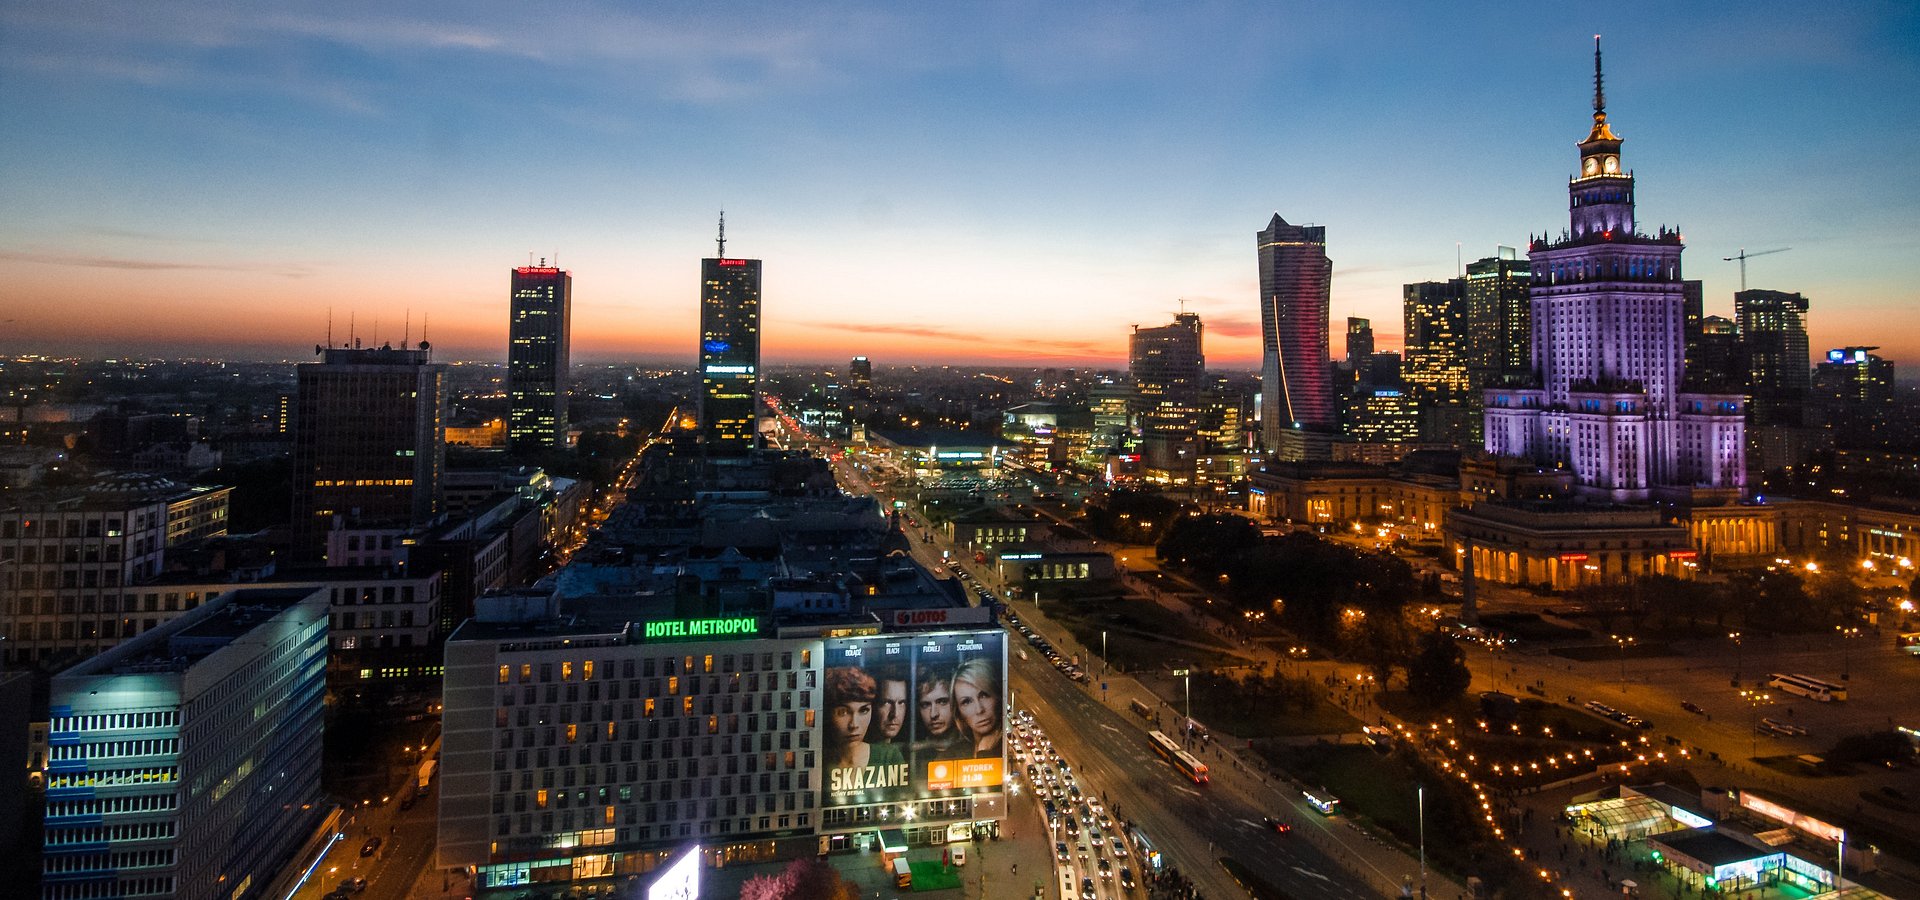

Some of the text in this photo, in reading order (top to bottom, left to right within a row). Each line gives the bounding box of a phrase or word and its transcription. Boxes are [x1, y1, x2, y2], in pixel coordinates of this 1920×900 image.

[911, 610, 947, 624] LOTOS
[645, 618, 758, 637] HOTEL METROPOL
[962, 763, 994, 773] WTOREK
[831, 763, 909, 791] SKAZANE
